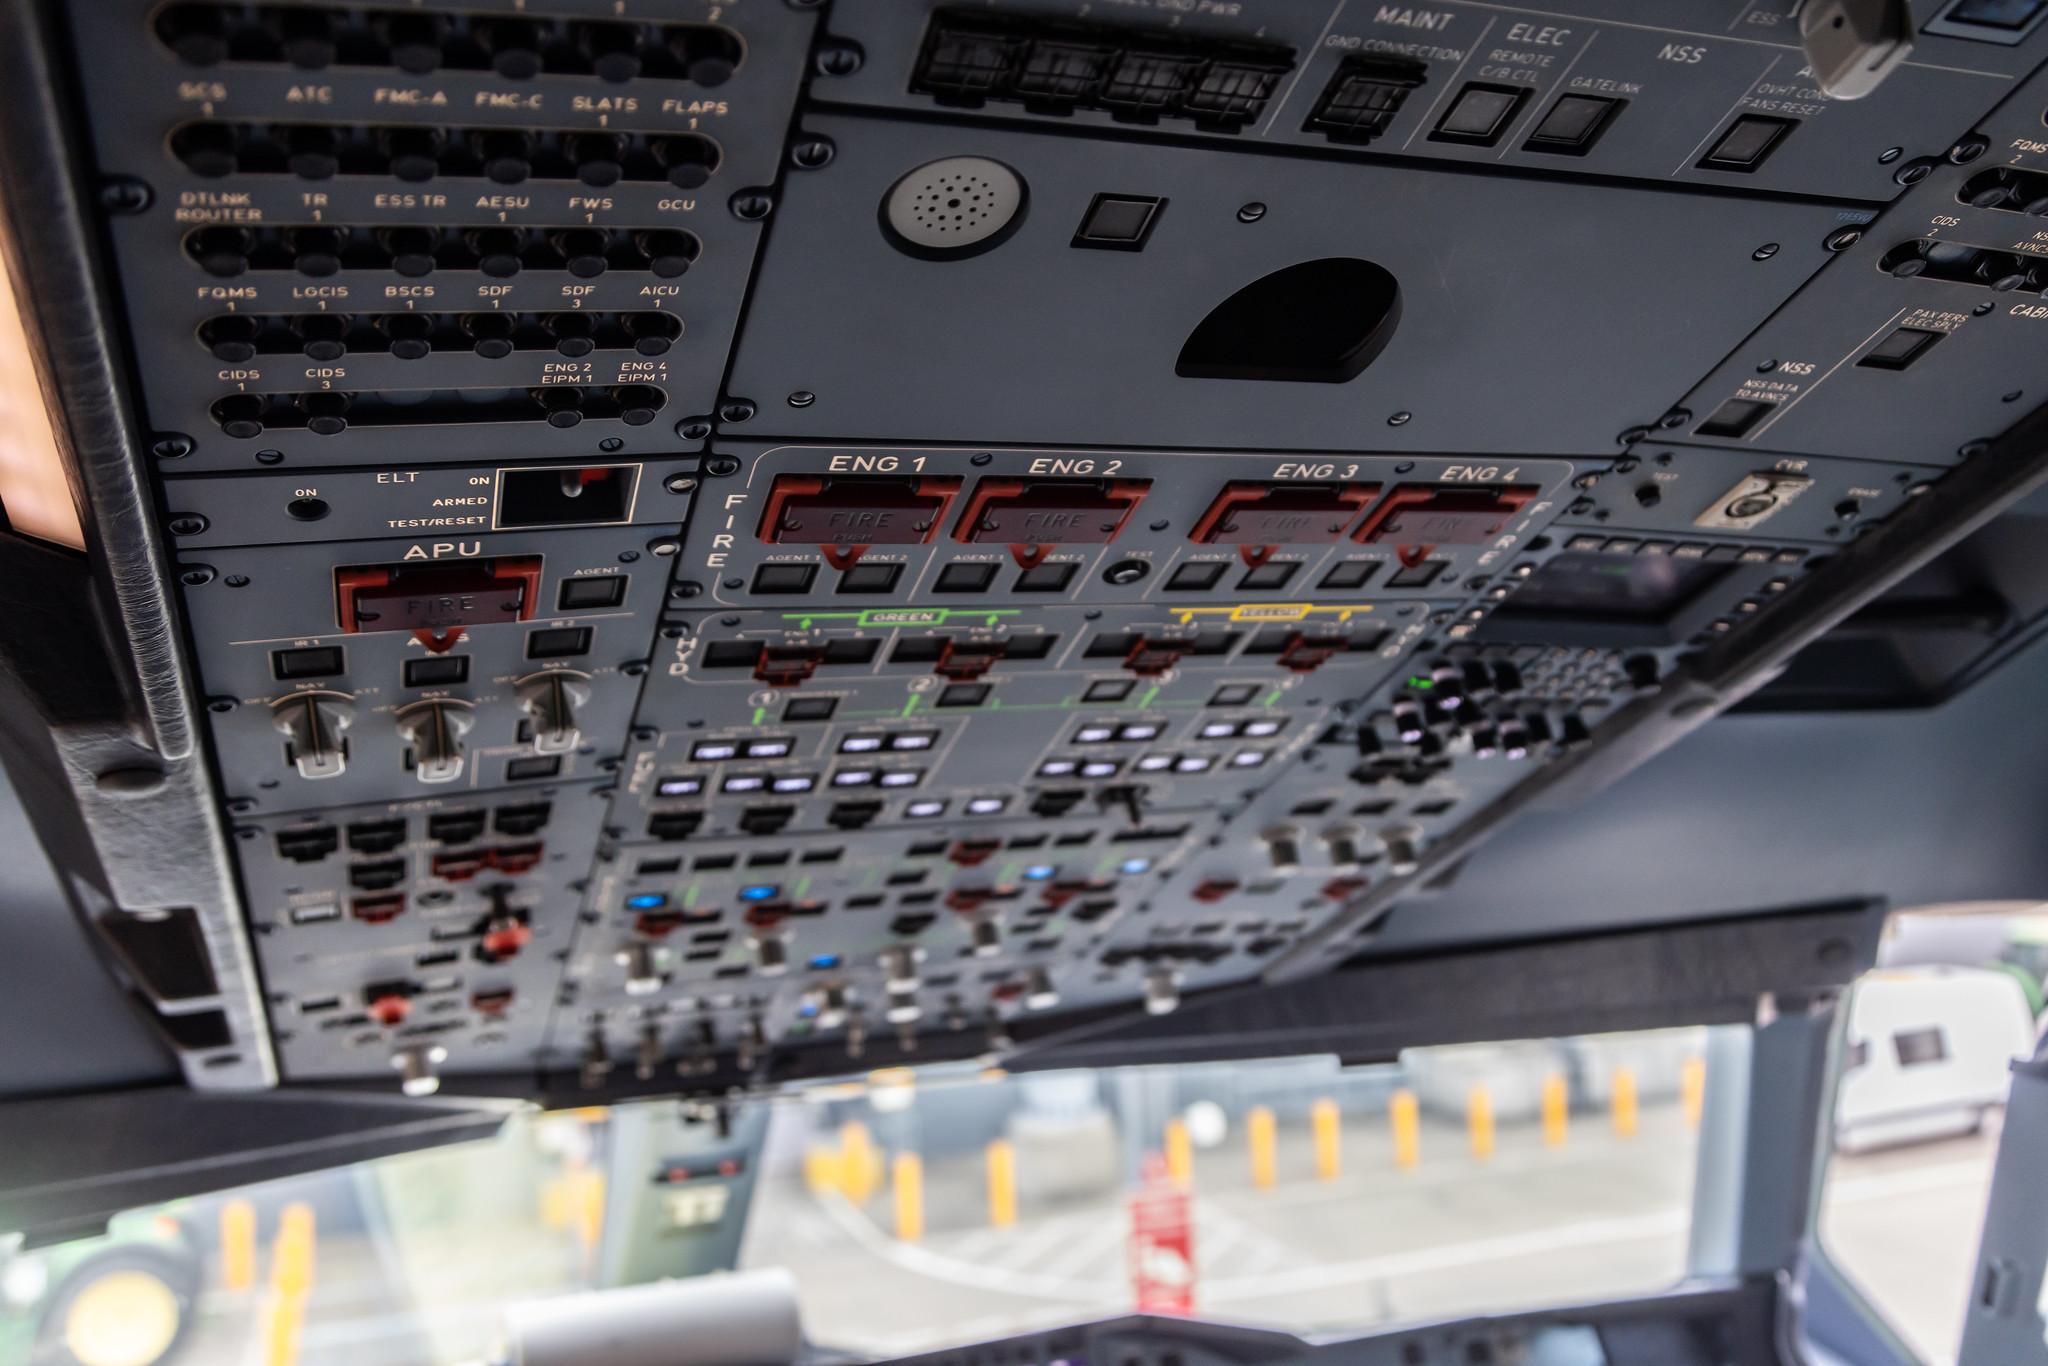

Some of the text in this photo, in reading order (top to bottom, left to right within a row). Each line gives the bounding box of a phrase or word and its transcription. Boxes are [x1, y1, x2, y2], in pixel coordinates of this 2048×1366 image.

[707, 5, 723, 24] 2
[1373, 5, 1455, 31] MAINT
[1507, 22, 1571, 46] ELEC
[1324, 34, 1466, 61] GND CONNECTION
[1657, 43, 1707, 64] NSS
[1488, 48, 1556, 67] REMOTE
[1479, 64, 1538, 82] C/B CTL
[1569, 76, 1645, 94] GATELINK
[1757, 83, 1798, 97] OVHT
[286, 84, 333, 104] ATC
[373, 87, 449, 106] FMC-A
[474, 90, 544, 110] FMC-C
[571, 94, 639, 112] SLATS
[661, 98, 729, 117] FLAPS
[1741, 96, 1827, 116] FANS RESET
[599, 114, 608, 127] 1
[688, 117, 698, 130] 1
[2009, 154, 2023, 164] 2
[302, 192, 329, 207] TR
[374, 193, 447, 208] ESS TR
[475, 195, 530, 209] AESU
[568, 196, 613, 210] FWS
[657, 198, 696, 211] GCU
[175, 208, 263, 223] ROUTER
[312, 209, 322, 223] 1
[497, 211, 507, 223] 1
[584, 212, 594, 223] 1
[1931, 215, 1961, 227] CIDS
[1927, 228, 1939, 238] 2
[198, 286, 258, 299] FQMS
[292, 286, 349, 298] LGCIS
[384, 285, 435, 297] BSCS
[478, 285, 513, 297] SDF
[561, 285, 596, 297] SDF
[639, 285, 680, 296] AICU
[226, 300, 236, 312] 1
[318, 300, 327, 311] 1
[406, 299, 415, 310] 1
[491, 298, 500, 309] 1
[572, 298, 581, 309] 3
[653, 298, 662, 309] 1
[1911, 308, 1969, 323] PAX PERS
[1901, 316, 1962, 331] ELEC SPLY
[543, 362, 593, 373] ENG 2
[620, 361, 667, 371] ENG 4
[1778, 360, 1816, 375] NSS
[218, 369, 261, 381] CIDS
[305, 367, 346, 379] CIDS
[541, 374, 593, 384] EIPM 1
[617, 372, 668, 383] EIPM 1
[237, 381, 245, 392] 1
[322, 379, 331, 390] 3
[1743, 378, 1799, 393] NSS DATA
[828, 455, 927, 472] ENG 1
[1028, 458, 1123, 475] ENG 2
[376, 471, 421, 484] ELT
[1272, 463, 1360, 479] ENG 3
[1439, 465, 1520, 481] ENG 4
[469, 476, 490, 485] ON
[295, 488, 318, 497] ON
[431, 496, 488, 507] ARMED
[387, 516, 487, 529] TEST/RESET
[828, 511, 895, 528] FIRE
[1024, 512, 1087, 528] FIRE
[706, 494, 748, 568] FIRE
[833, 533, 874, 544] PUSH
[403, 540, 481, 561] APU
[765, 554, 822, 562] AGENT 1
[899, 554, 908, 562] 2
[952, 554, 997, 562] AGENT
[573, 566, 621, 576] AGENT
[407, 596, 476, 616] FIRE
[872, 612, 935, 622] GREEN
[668, 636, 699, 677] HYD
